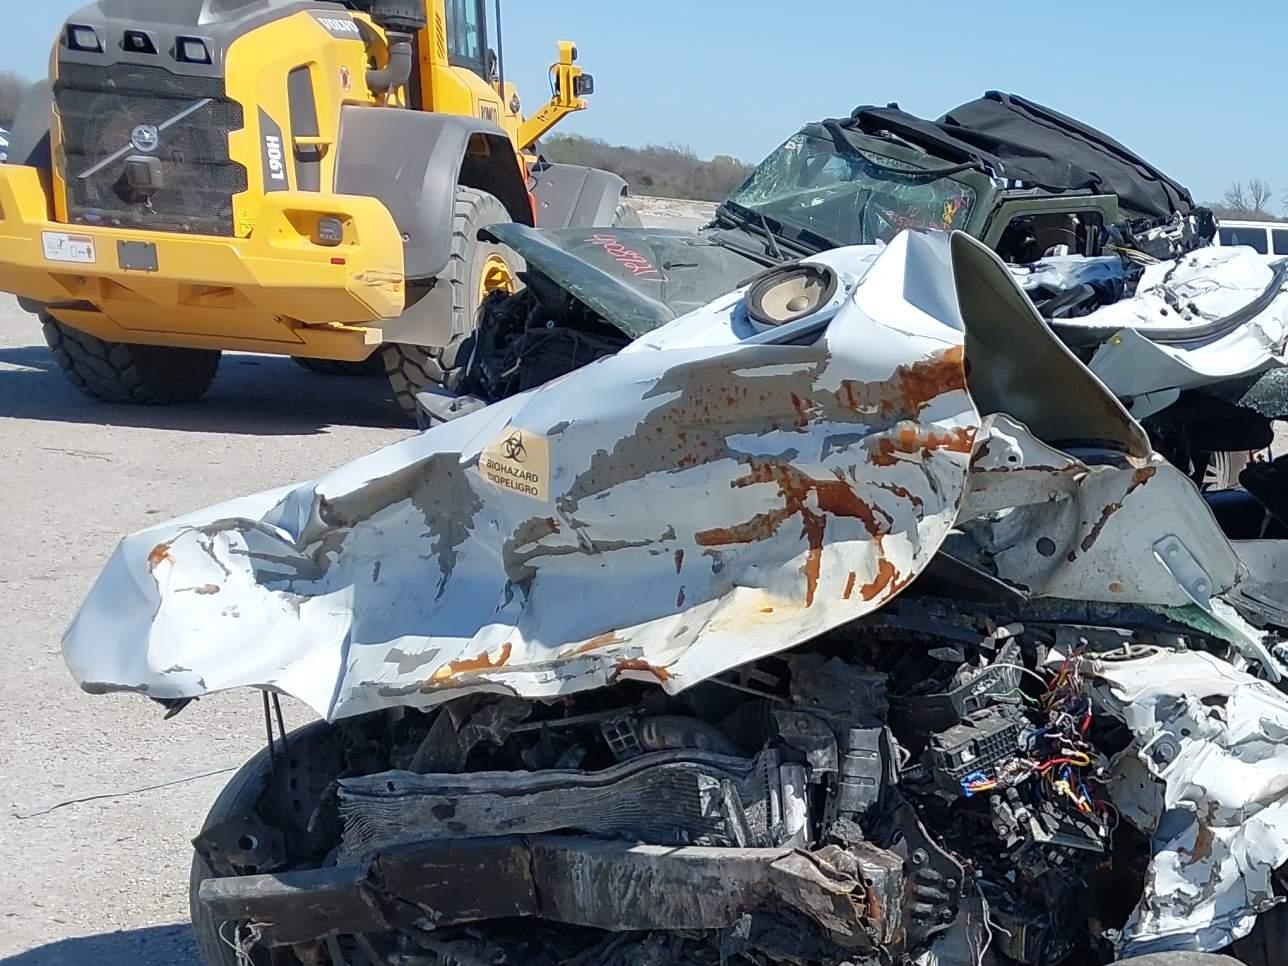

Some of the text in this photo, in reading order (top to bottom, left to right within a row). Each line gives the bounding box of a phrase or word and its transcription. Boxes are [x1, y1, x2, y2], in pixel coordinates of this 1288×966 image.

[317, 18, 359, 33] VOLVO
[265, 136, 285, 180] L90H
[486, 459, 539, 483] BIOHAZARD
[487, 472, 539, 496] BIOPELIGRO
